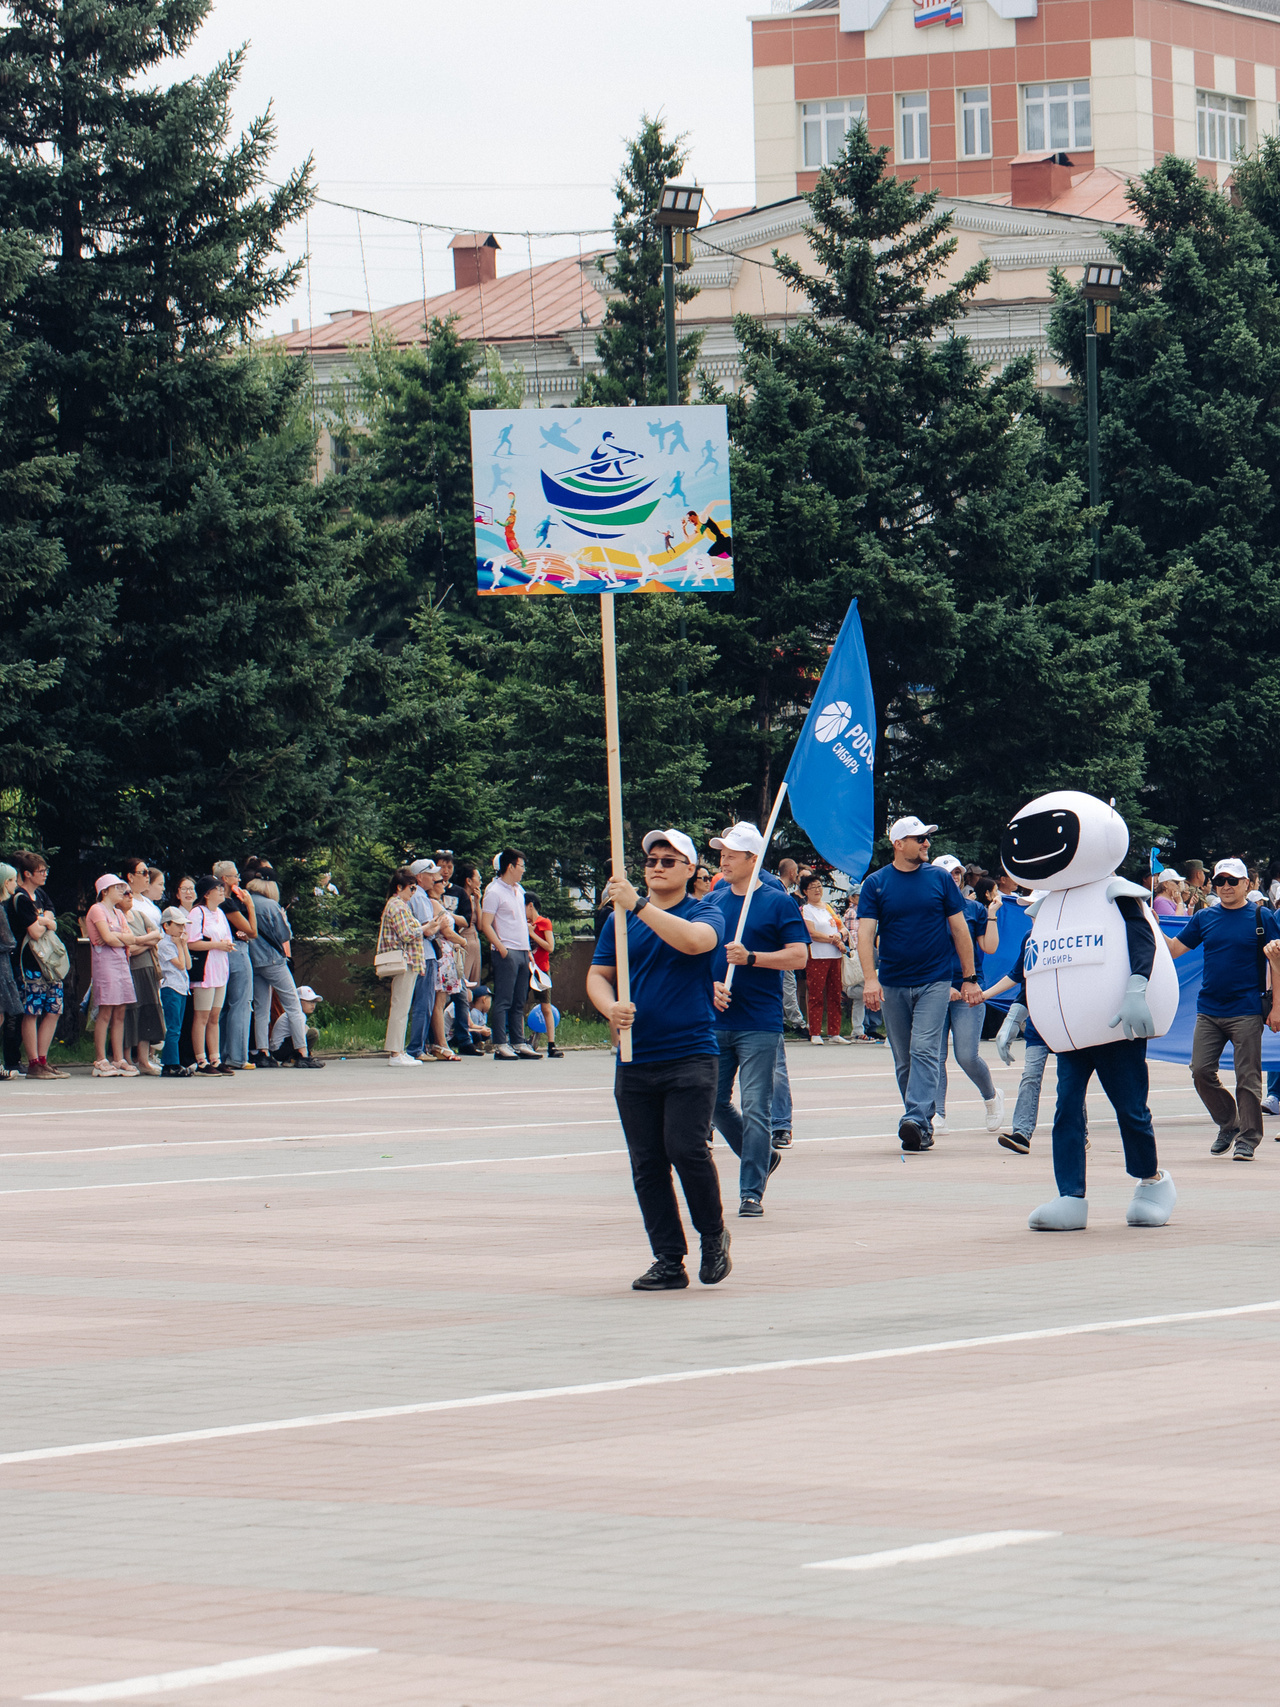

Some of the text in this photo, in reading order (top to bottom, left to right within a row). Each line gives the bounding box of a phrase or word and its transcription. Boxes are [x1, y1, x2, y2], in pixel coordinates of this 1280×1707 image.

[832, 742, 860, 774] СИБИРЬ
[1042, 934, 1103, 952] РОССЕТИ
[1042, 954, 1073, 966] СИБИРЬ
